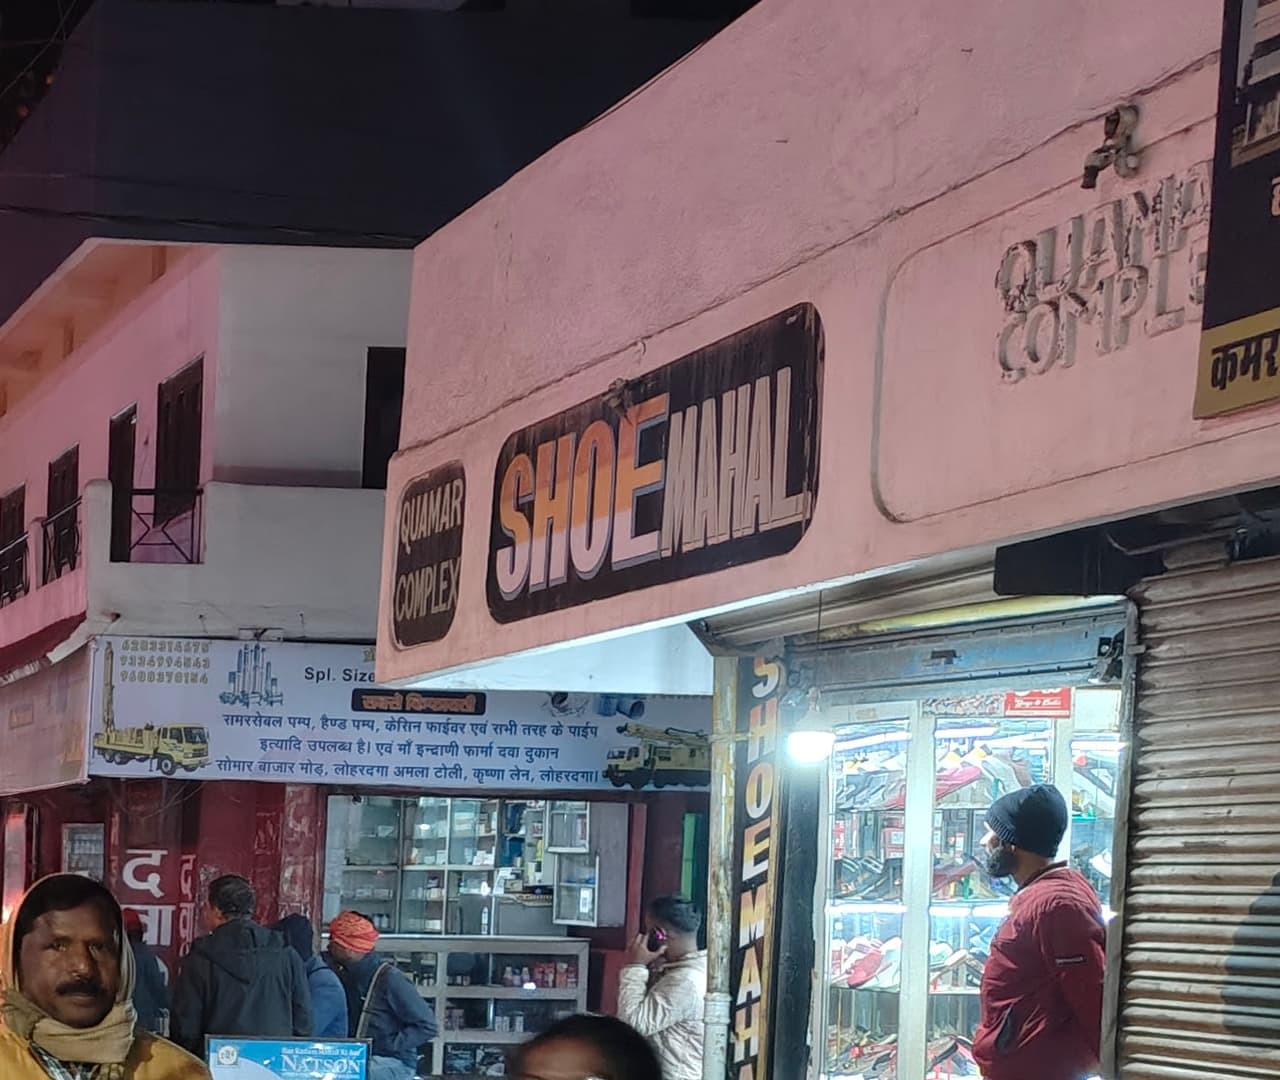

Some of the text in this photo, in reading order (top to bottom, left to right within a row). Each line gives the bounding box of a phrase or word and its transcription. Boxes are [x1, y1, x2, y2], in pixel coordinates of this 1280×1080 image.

[995, 233, 1207, 384] COMPLE
[495, 366, 811, 602] SHOE MAHAL
[399, 477, 463, 554] QUAMAR
[395, 555, 462, 622] COMPLEX
[304, 667, 336, 683] Spl.
[258, 735, 302, 752] इत्यादि
[374, 740, 395, 757] एवं
[496, 746, 521, 759] दवा
[469, 718, 488, 736] एवं
[521, 721, 547, 738] तरह
[550, 721, 564, 738] के
[281, 1055, 361, 1073] NATSON
